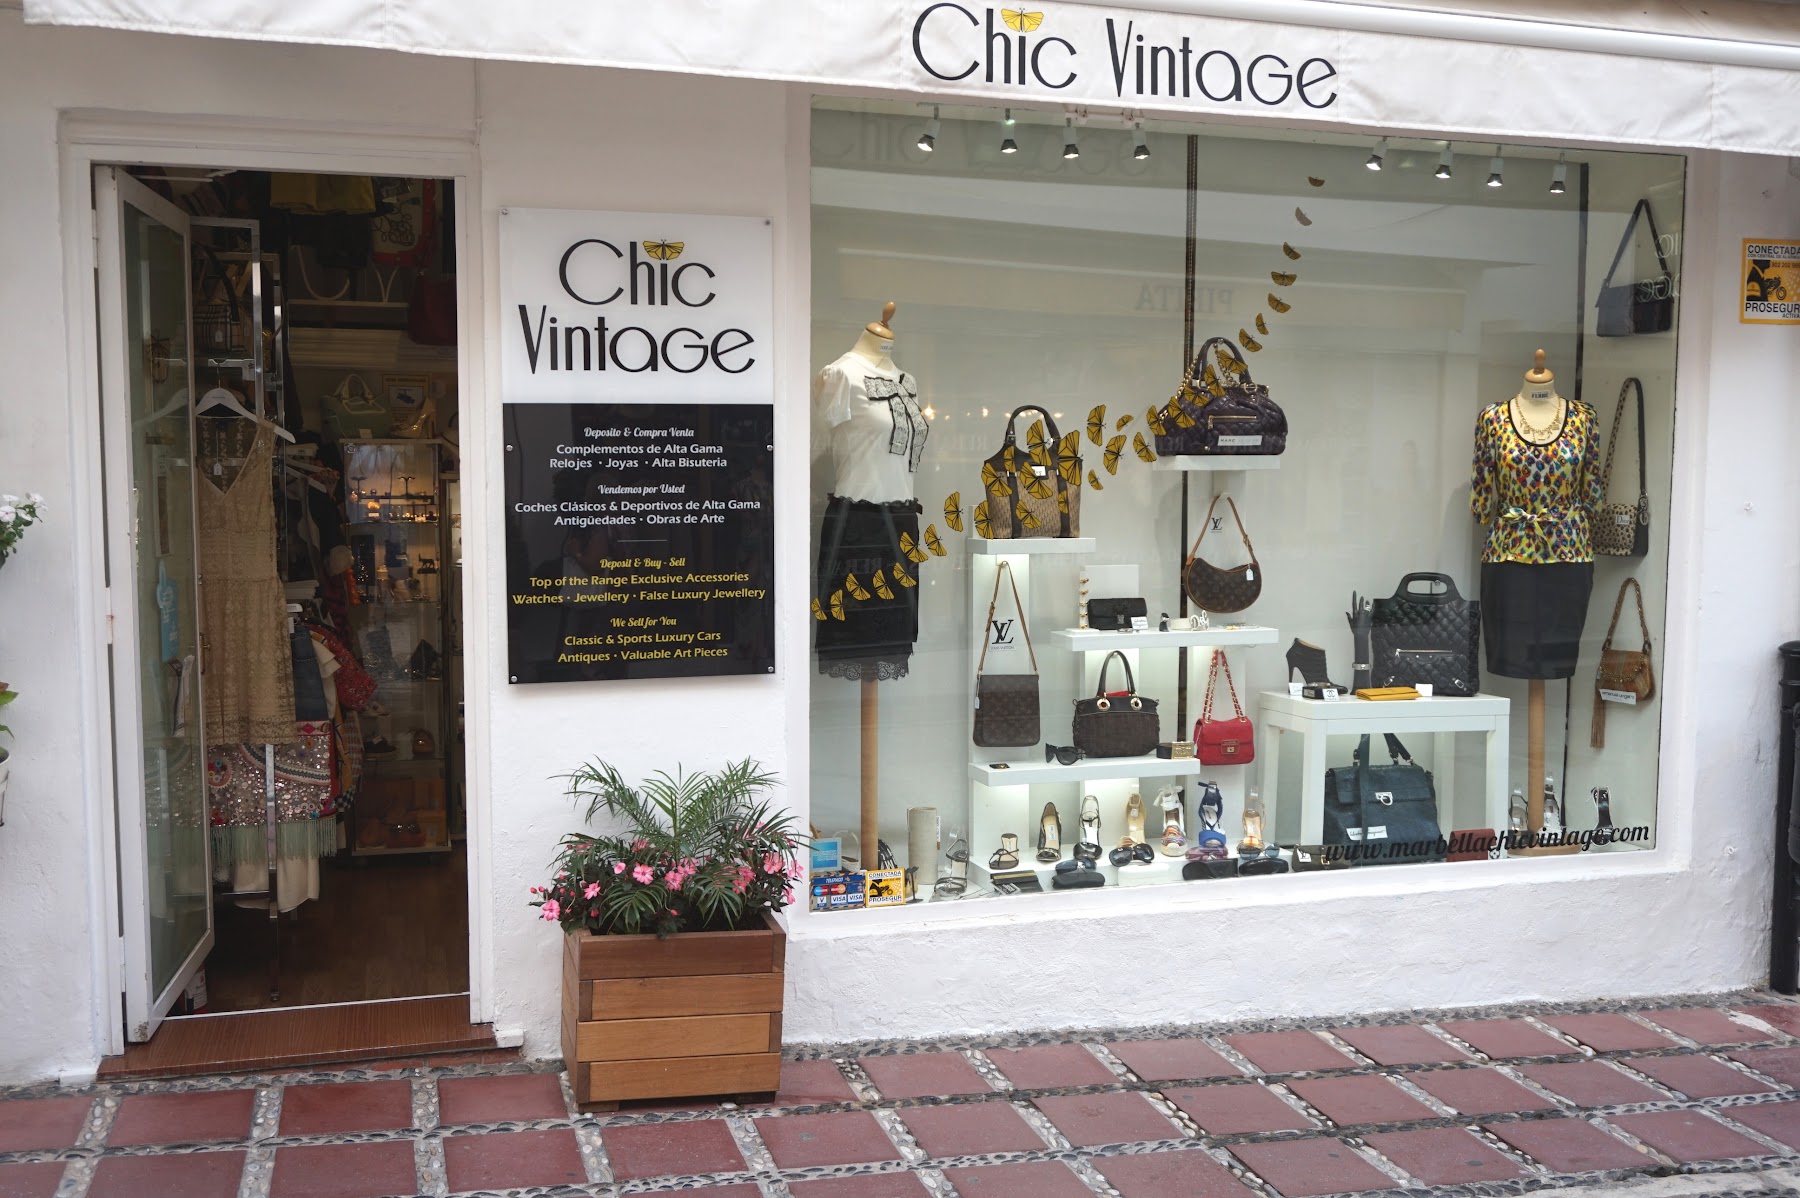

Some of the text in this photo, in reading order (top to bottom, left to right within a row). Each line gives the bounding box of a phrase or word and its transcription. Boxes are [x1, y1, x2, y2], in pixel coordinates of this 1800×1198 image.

[912, 2, 1078, 89] Chic
[1747, 244, 1800, 254] CONECTADA
[558, 238, 716, 308] Chic
[1745, 302, 1800, 313] PROSEGUR
[584, 427, 694, 440] Deposito & Compra Venta
[556, 443, 723, 456] Complementos de Alta Gama
[550, 457, 727, 470] Relojes Joyas Alta Bisuteria
[597, 483, 686, 497] Vendemos por Usted
[514, 500, 761, 512] Coches Clásicos & Deportivos de Alta Gama
[554, 513, 725, 528] Antigüedades Obras de Arte
[600, 558, 632, 570] Deposit
[633, 558, 641, 568] &
[643, 557, 662, 570] Buy
[668, 557, 686, 567] Sell
[529, 572, 749, 589] Top of the Range Exclusive Accessories
[513, 588, 766, 604] Watches Jewellery False Luxury Jewellery
[610, 617, 677, 628] We Sell for You
[564, 631, 721, 646] Classic & Sports Luxury Cars
[558, 647, 728, 664] Antiques Valuable Art Pieces
[1324, 823, 1650, 861] www.marbellachicvintage.com
